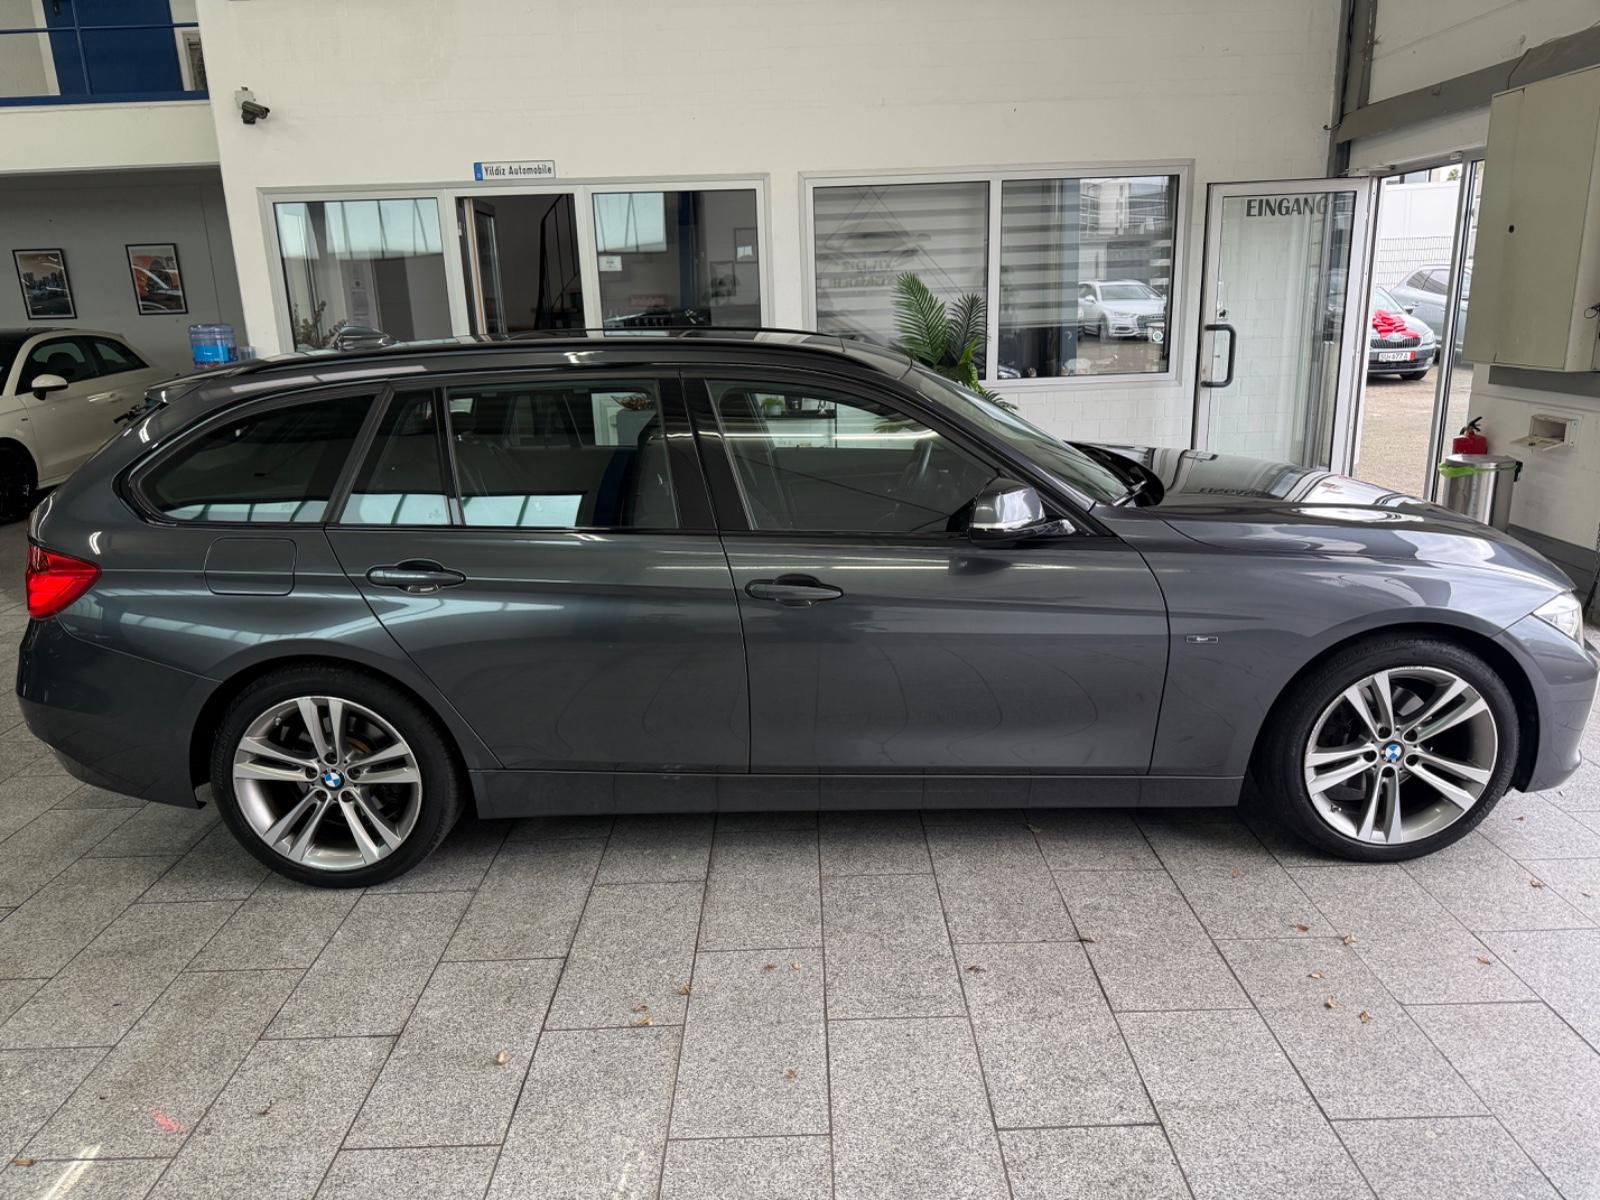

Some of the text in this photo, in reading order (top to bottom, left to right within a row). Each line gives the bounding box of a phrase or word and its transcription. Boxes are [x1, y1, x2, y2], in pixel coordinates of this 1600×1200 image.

[484, 165, 507, 177] Yildiz
[508, 164, 552, 176] Automobile
[1246, 196, 1329, 217] EINGANG
